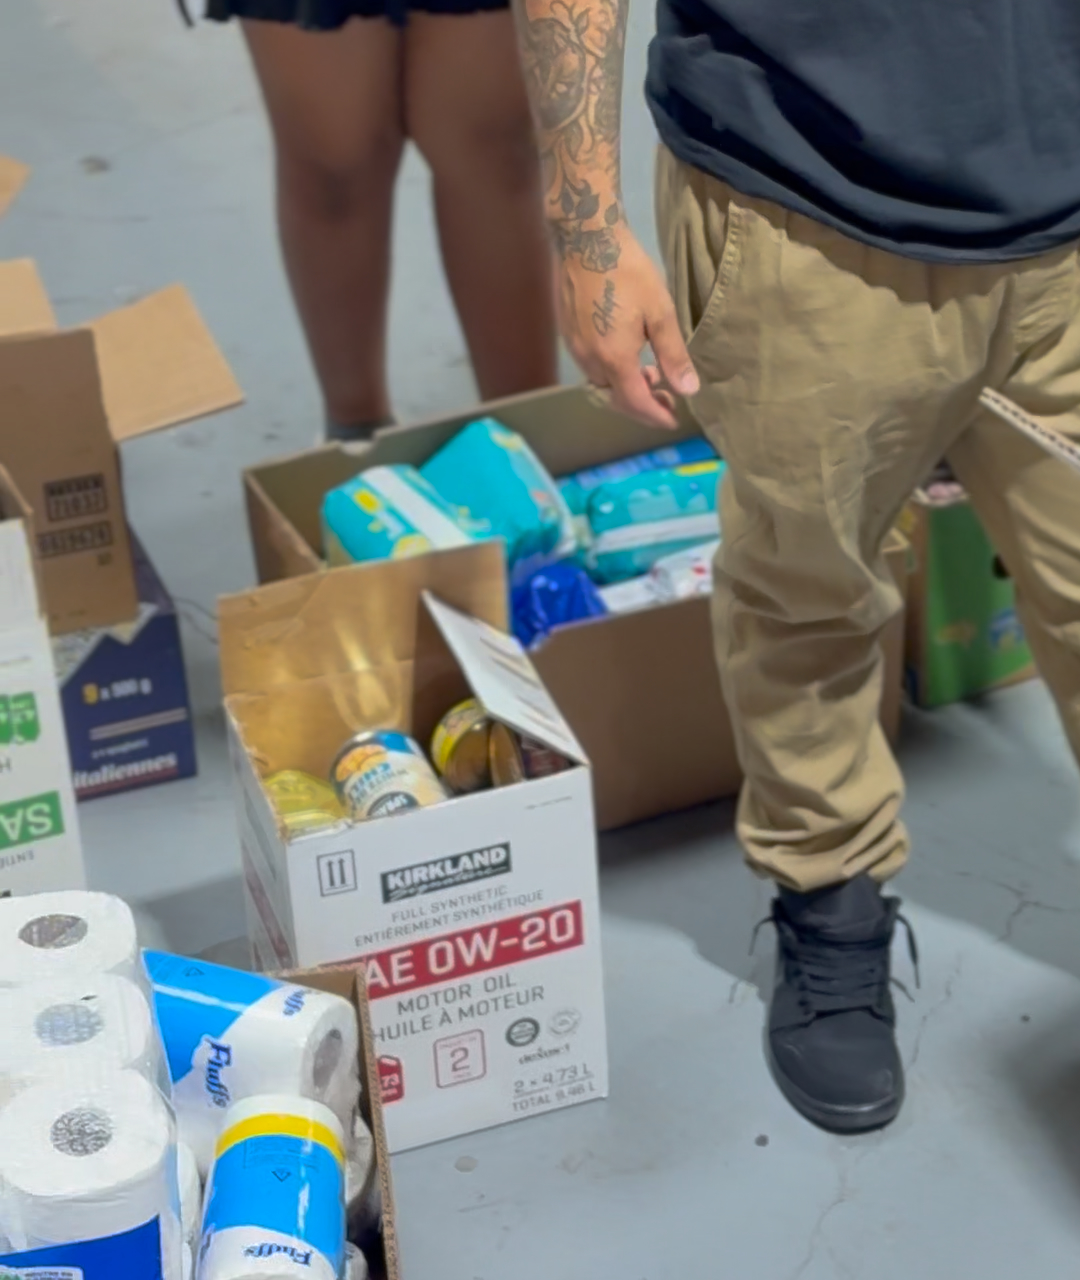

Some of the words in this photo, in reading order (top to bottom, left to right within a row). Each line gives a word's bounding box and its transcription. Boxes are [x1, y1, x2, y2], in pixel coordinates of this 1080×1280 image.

[386, 846, 507, 893] KIRKLAND
[391, 904, 426, 923] FULL
[430, 885, 508, 915] SYNTHETIC
[373, 1014, 434, 1042] HUILE
[438, 1006, 453, 1028] À
[458, 984, 546, 1022] MOTEUR
[397, 983, 473, 1015] MOTOR
[483, 973, 517, 994] OIL
[449, 1046, 471, 1073] 2
